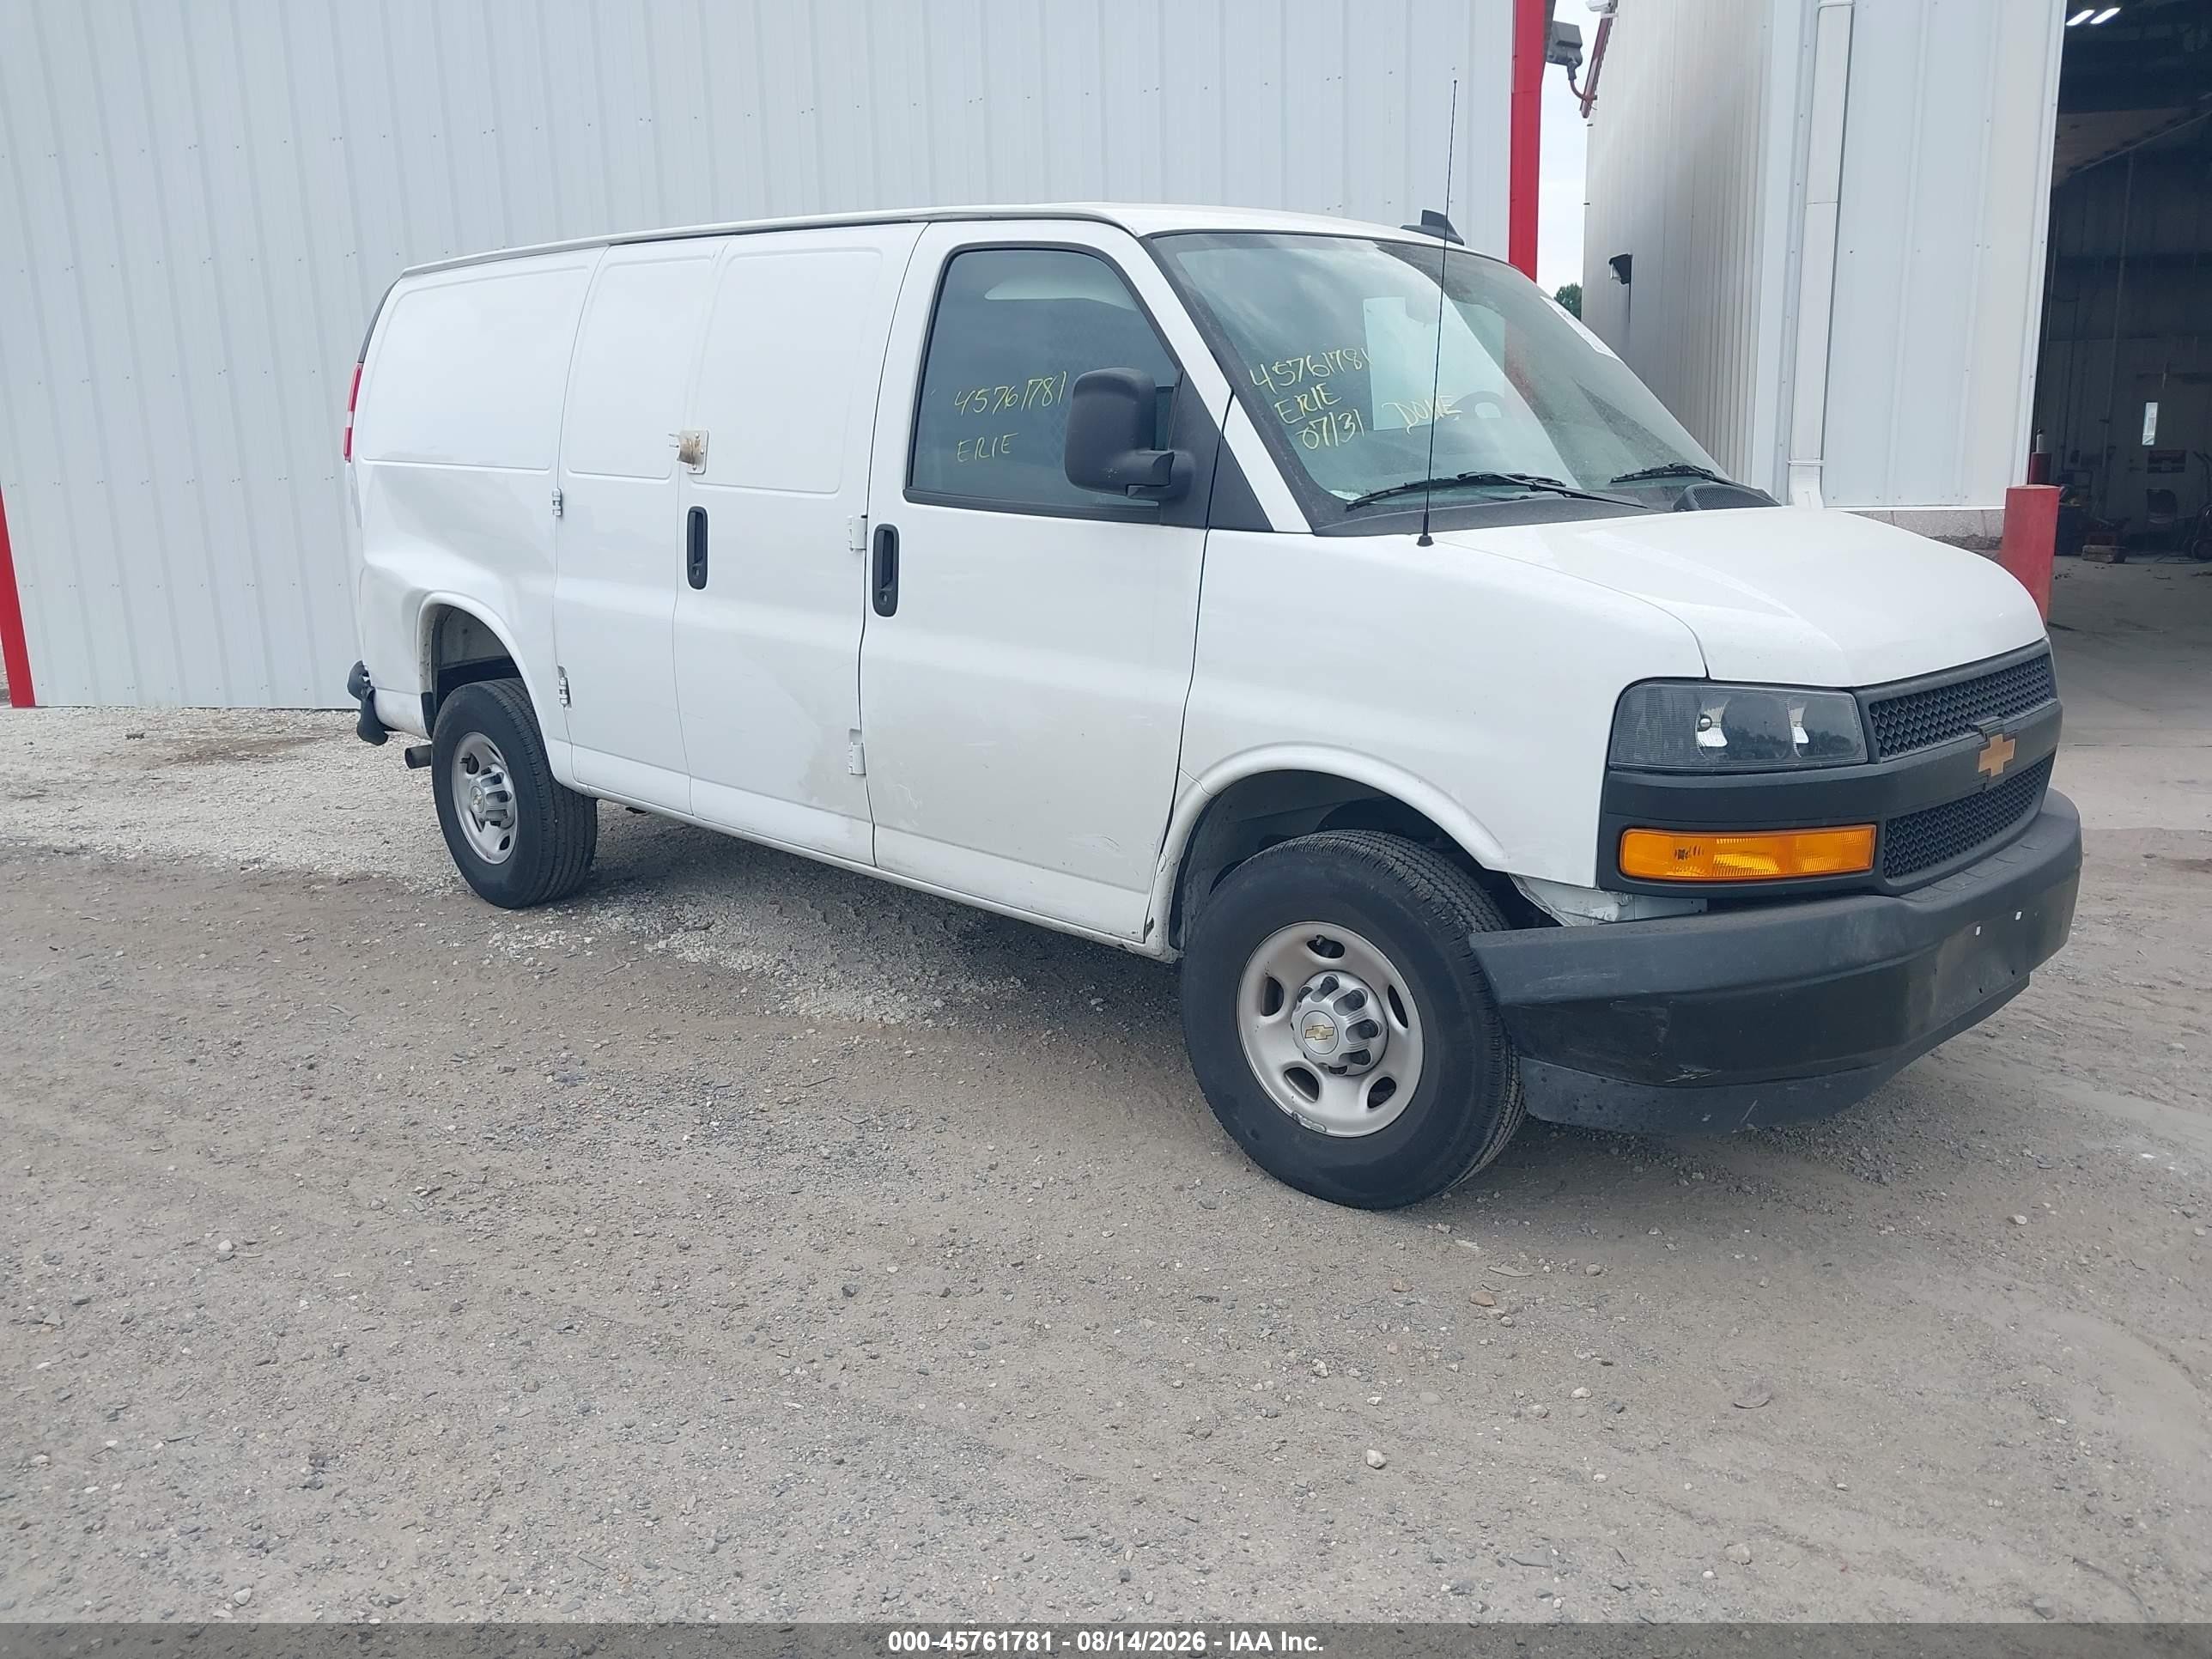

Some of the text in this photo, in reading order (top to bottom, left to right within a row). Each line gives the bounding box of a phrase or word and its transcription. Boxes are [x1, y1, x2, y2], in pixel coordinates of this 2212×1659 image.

[1249, 347, 1374, 395] 45761781
[954, 370, 1068, 416] 45761781
[1274, 383, 1342, 425] ERIE
[956, 432, 1019, 463] ERIE
[1295, 408, 1365, 451] 07/31
